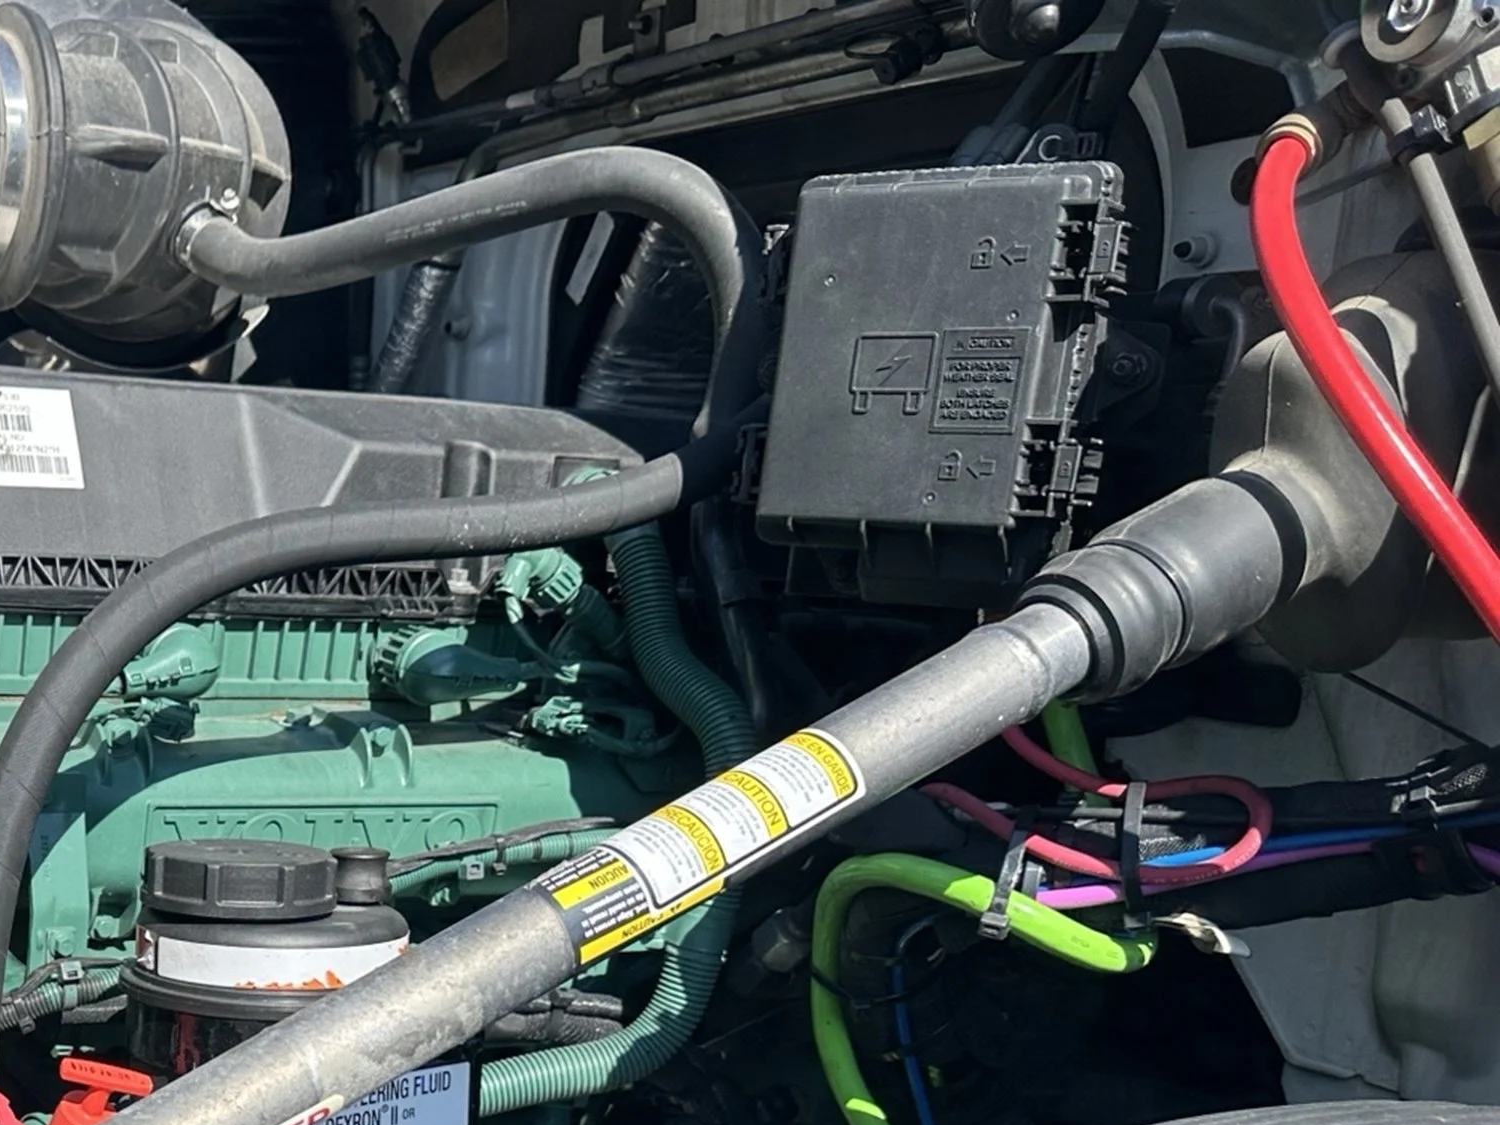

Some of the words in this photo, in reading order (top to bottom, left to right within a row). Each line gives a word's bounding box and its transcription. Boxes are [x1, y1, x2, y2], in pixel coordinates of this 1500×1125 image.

[806, 741, 825, 755] EN
[821, 753, 850, 794] GARDE
[723, 773, 781, 827] CAUTION
[665, 807, 719, 870] RECAUCION
[587, 863, 629, 890] AUCION
[413, 1071, 451, 1096] FLUID
[390, 1105, 399, 1125] II
[402, 1107, 416, 1120] OR
